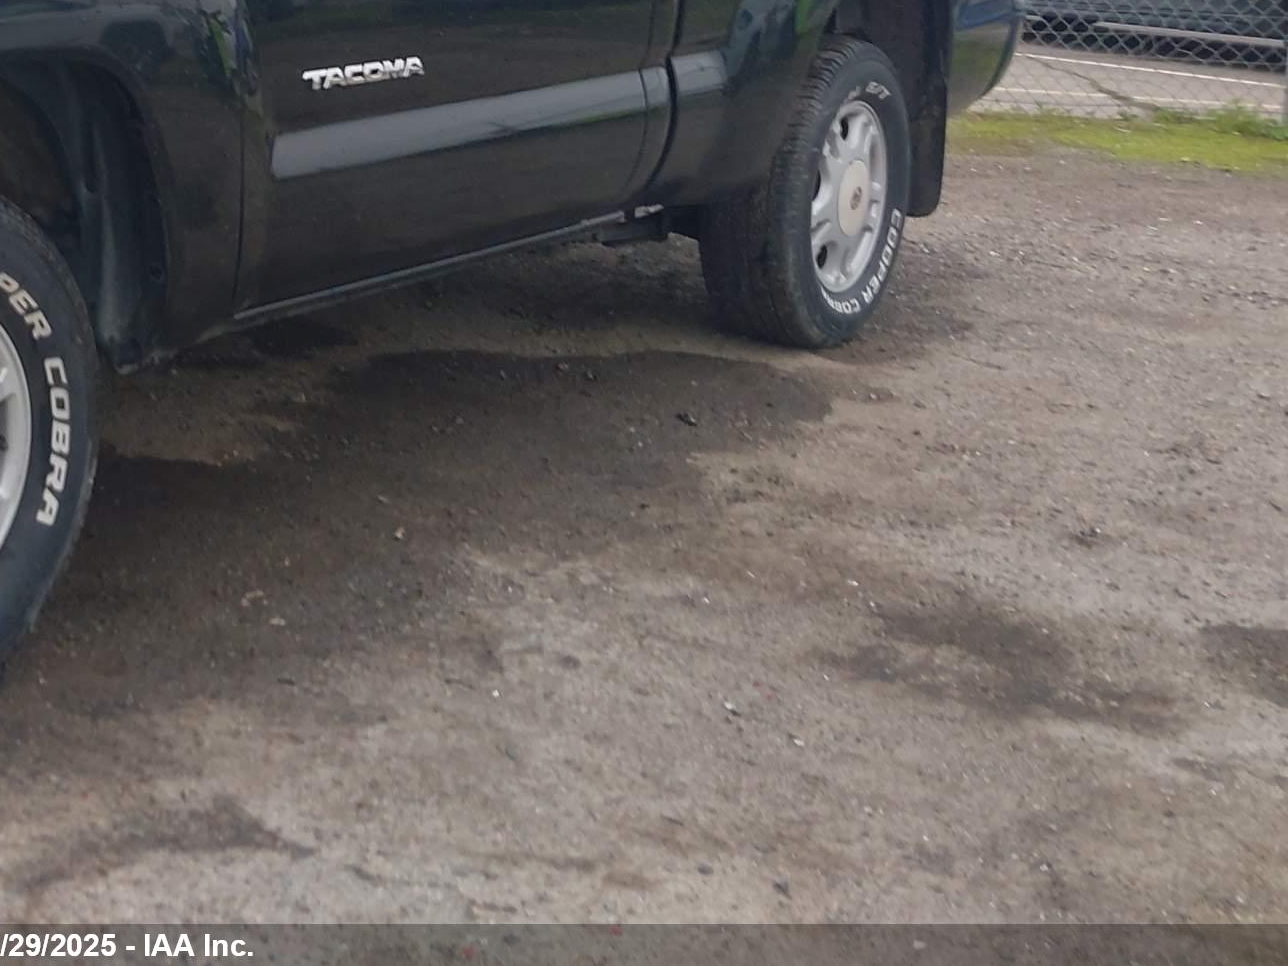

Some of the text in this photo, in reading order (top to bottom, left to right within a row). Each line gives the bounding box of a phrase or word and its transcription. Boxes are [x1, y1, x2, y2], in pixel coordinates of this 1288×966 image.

[302, 56, 424, 90] TACOMA
[862, 208, 904, 304] COOPER
[35, 355, 74, 527] COBRA
